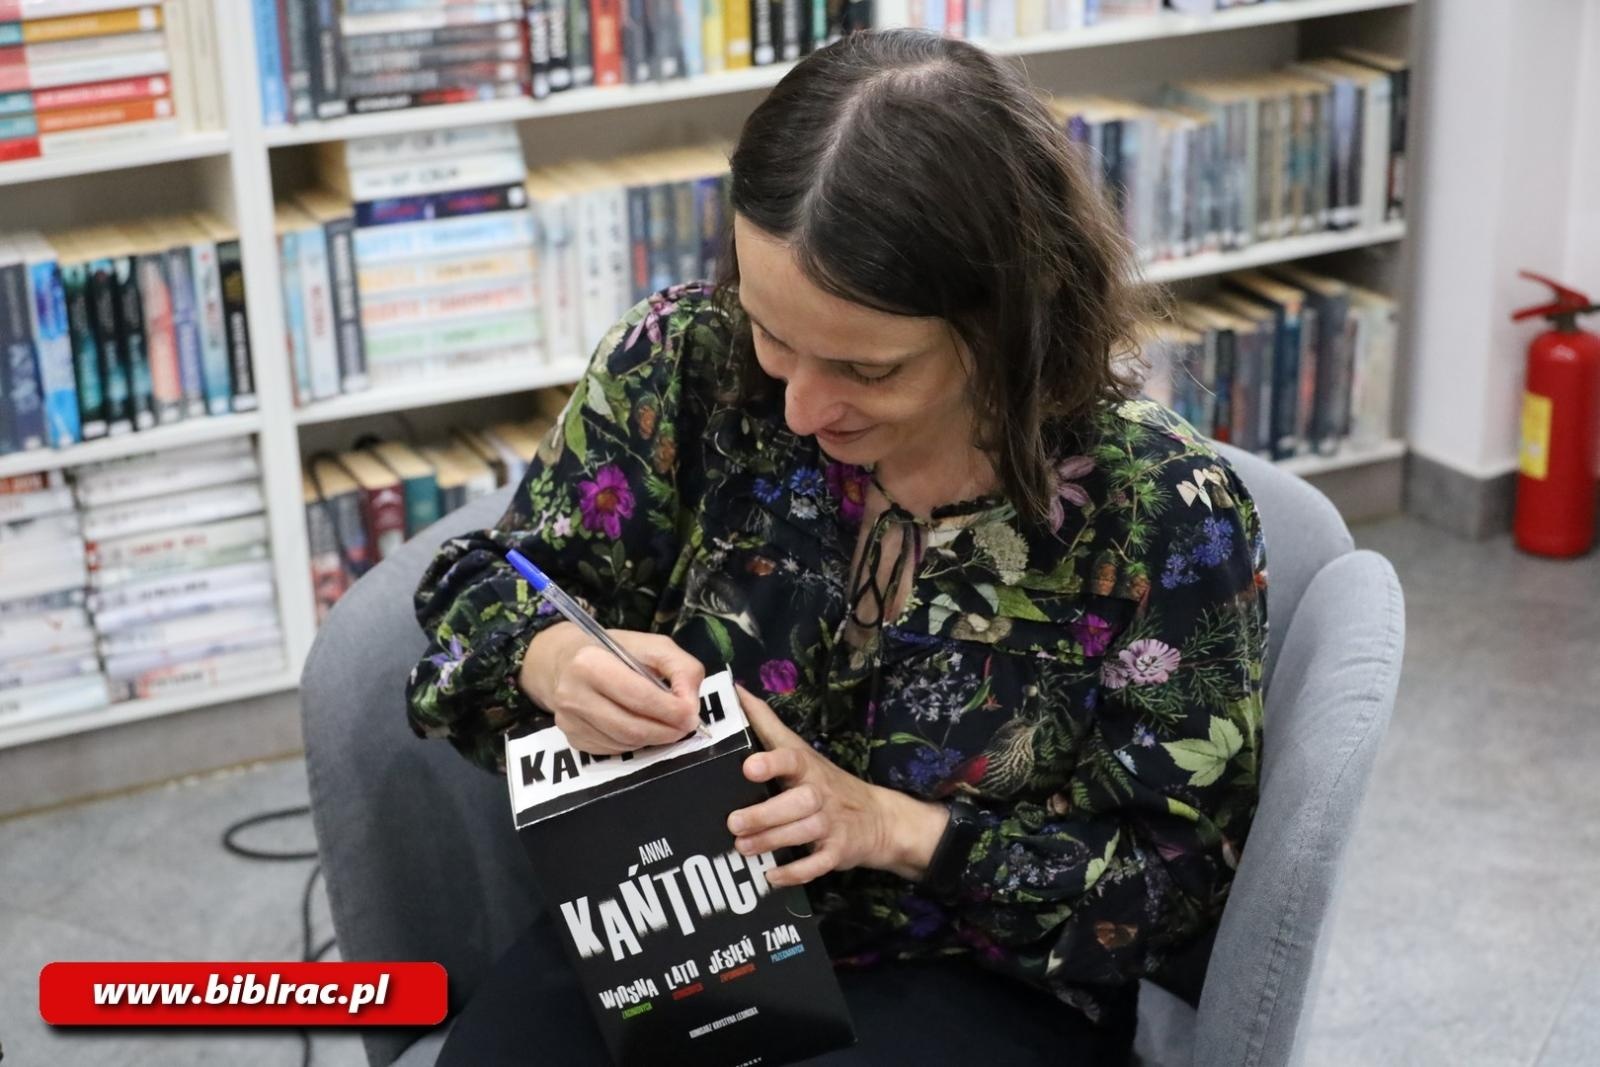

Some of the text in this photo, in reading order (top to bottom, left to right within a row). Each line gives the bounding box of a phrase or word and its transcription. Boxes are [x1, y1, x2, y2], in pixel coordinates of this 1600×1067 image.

[638, 837, 673, 866] ANNA
[560, 849, 778, 961] KAŃTOCH
[598, 978, 660, 1009] WIOSNA
[664, 960, 700, 990] LATO
[708, 935, 756, 974] JESIEŃ
[762, 924, 801, 952] ZIMA
